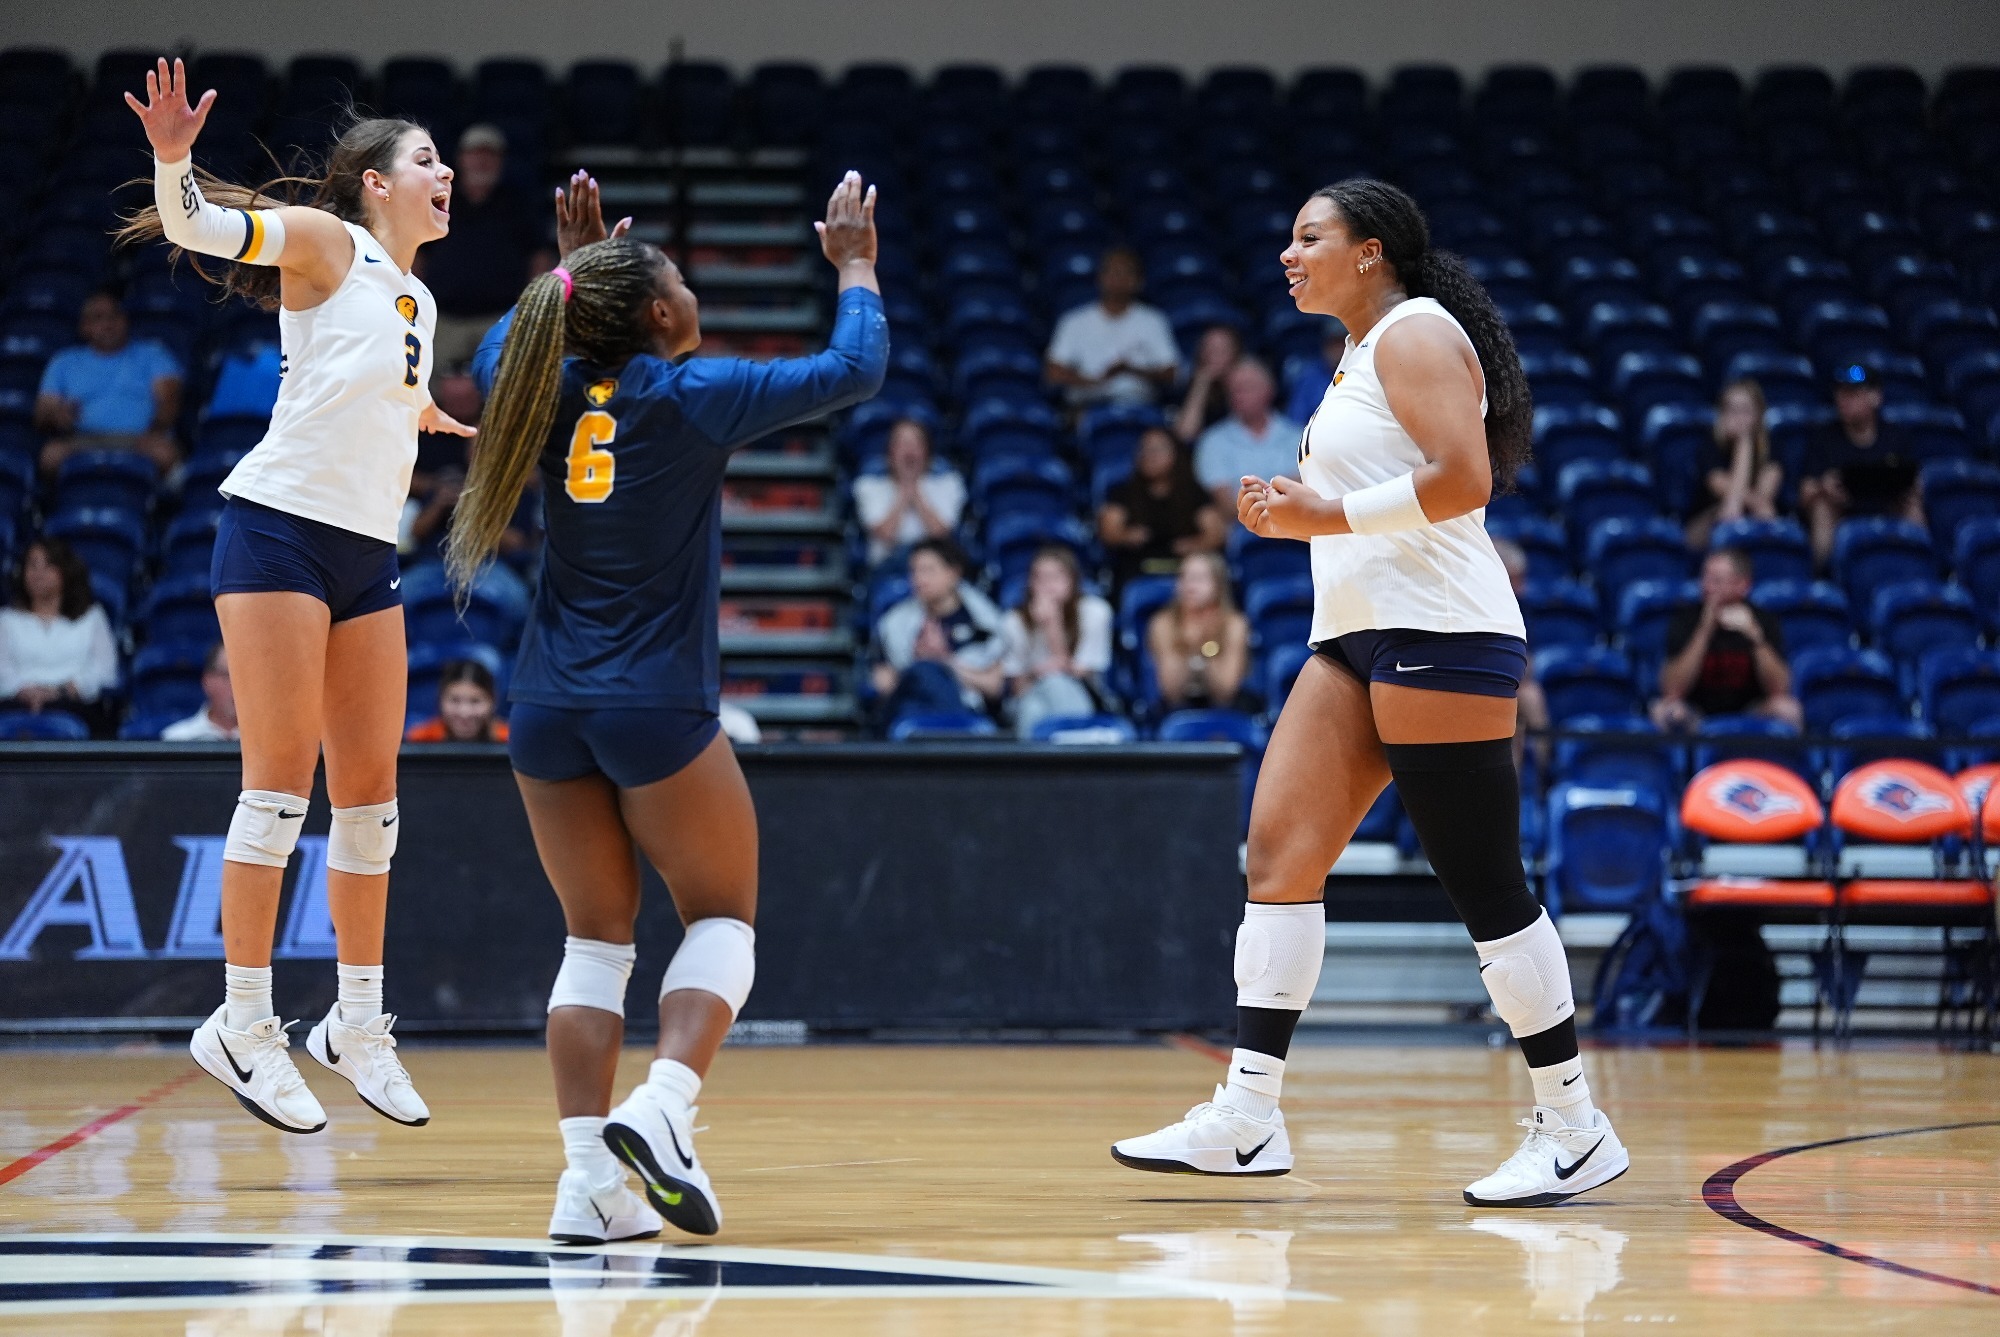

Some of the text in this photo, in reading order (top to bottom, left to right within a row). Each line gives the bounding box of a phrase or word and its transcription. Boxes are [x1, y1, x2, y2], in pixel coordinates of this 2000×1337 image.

[180, 168, 200, 219] EAST
[403, 330, 422, 388] 2
[565, 410, 617, 503] 6
